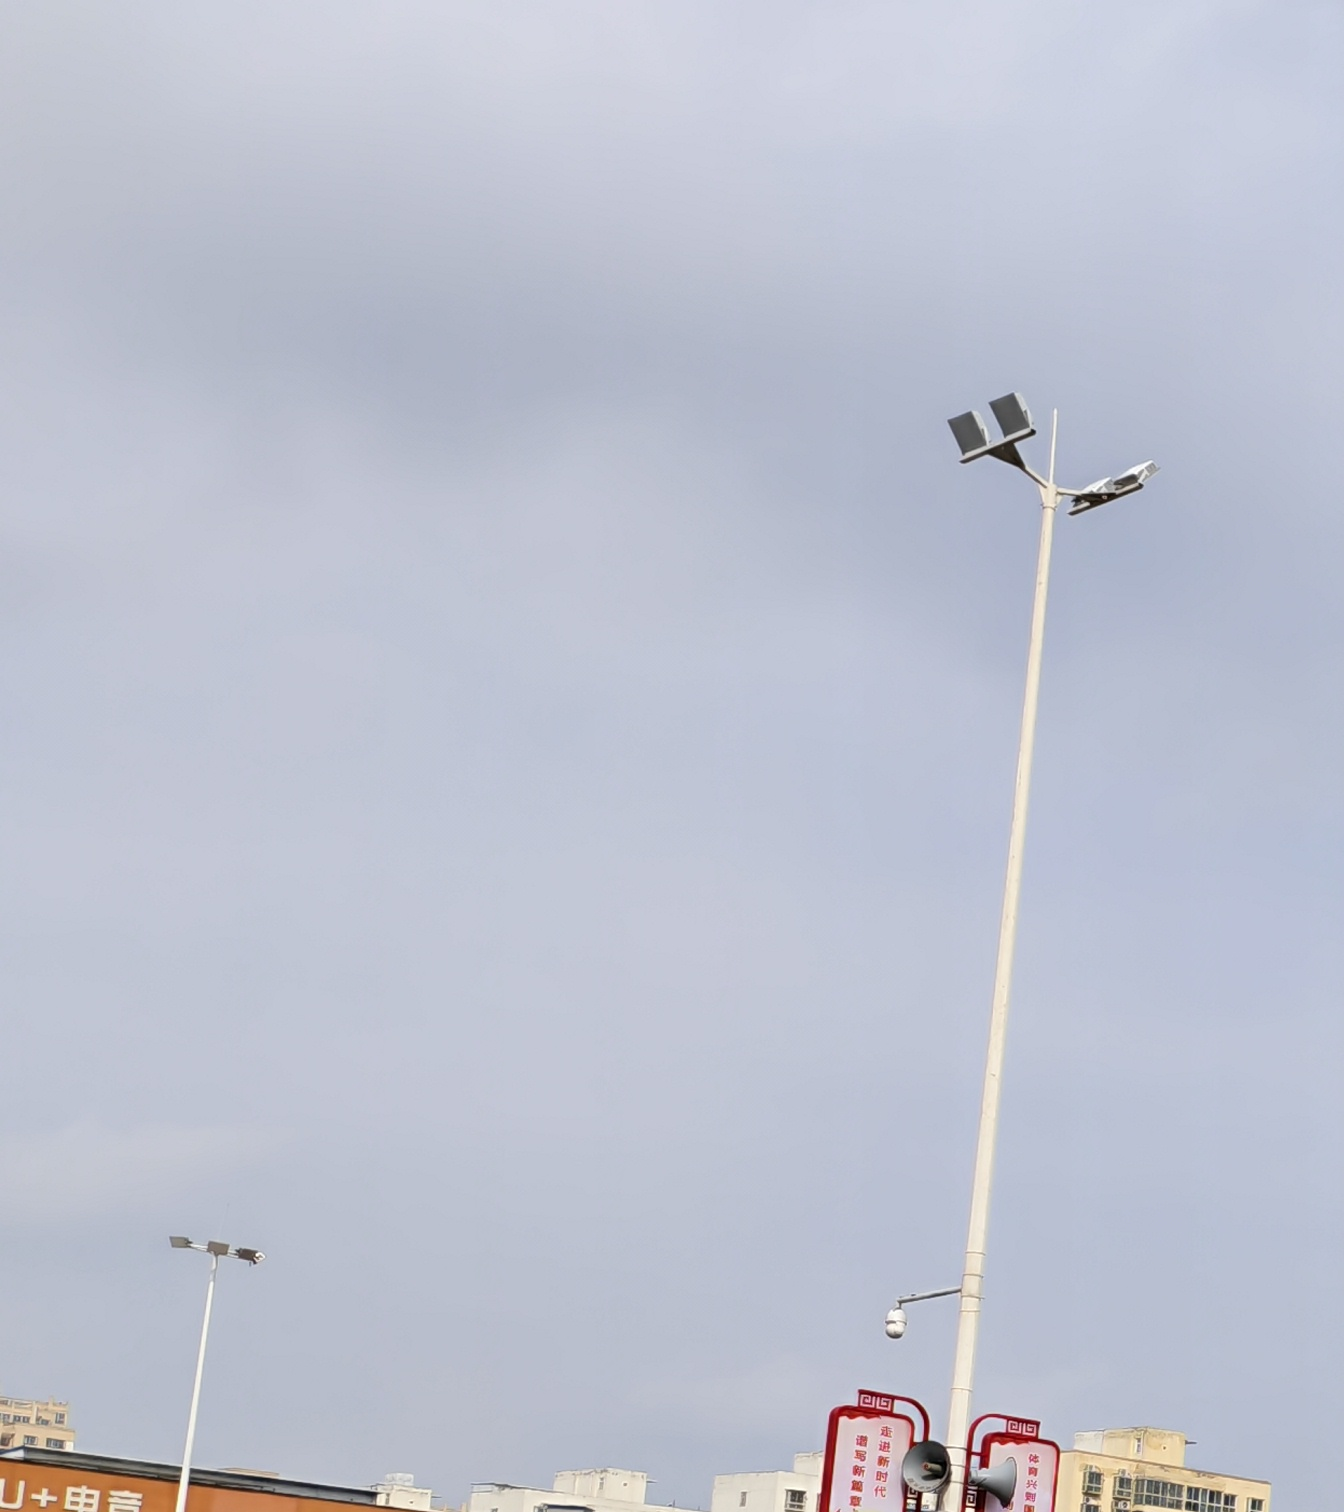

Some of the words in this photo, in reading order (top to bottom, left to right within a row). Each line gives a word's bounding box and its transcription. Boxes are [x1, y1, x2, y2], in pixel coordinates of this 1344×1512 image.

[849, 1434, 868, 1507] 谱写新篇章
[874, 1425, 893, 1498] 走进新时代
